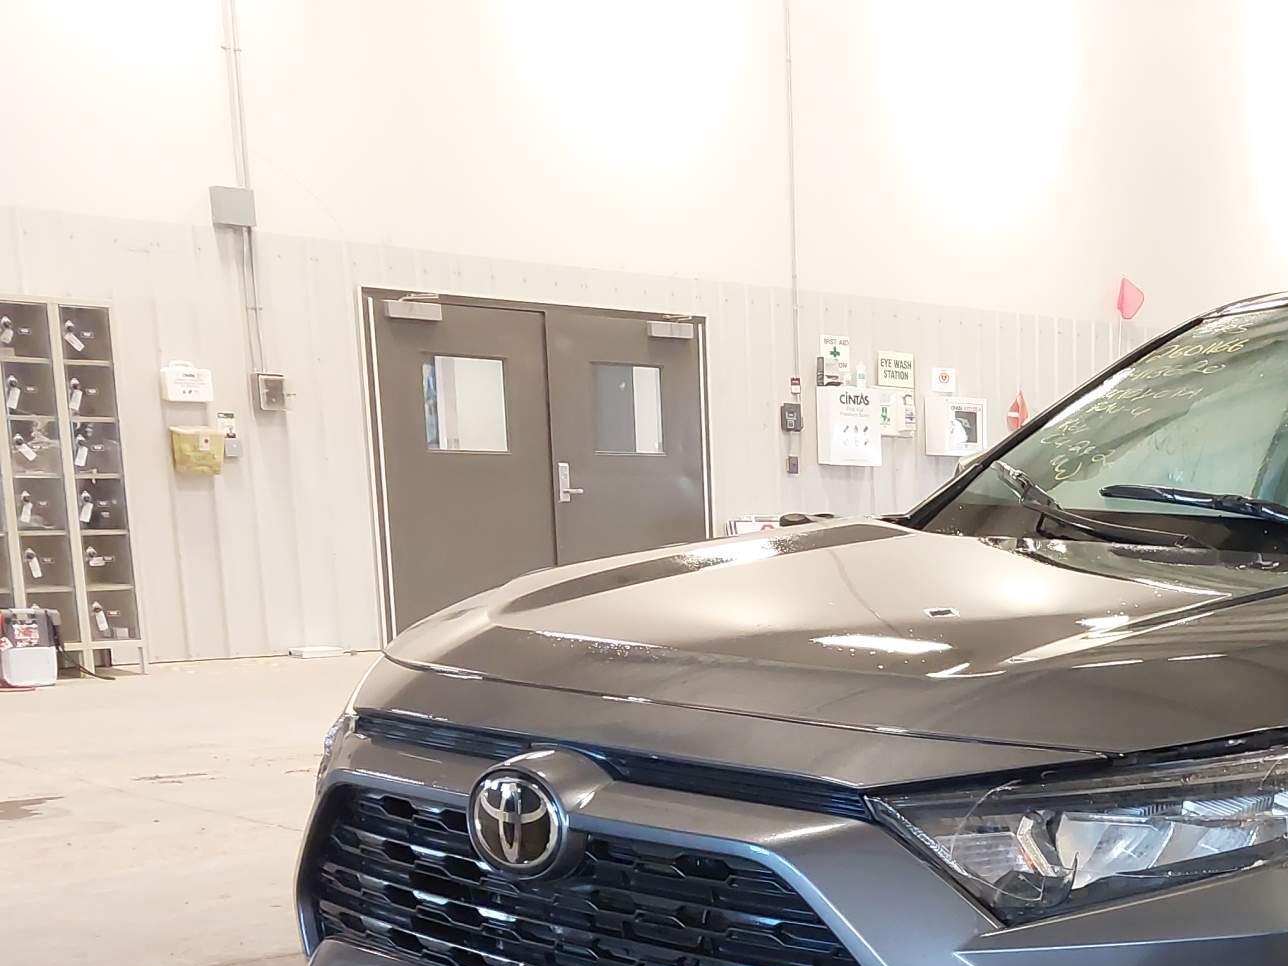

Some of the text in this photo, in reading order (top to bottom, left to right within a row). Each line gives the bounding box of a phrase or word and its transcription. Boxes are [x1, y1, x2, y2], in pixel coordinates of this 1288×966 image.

[880, 358, 912, 370] EYE WASH
[883, 369, 909, 381] STATION
[839, 391, 870, 406] CINTAS
